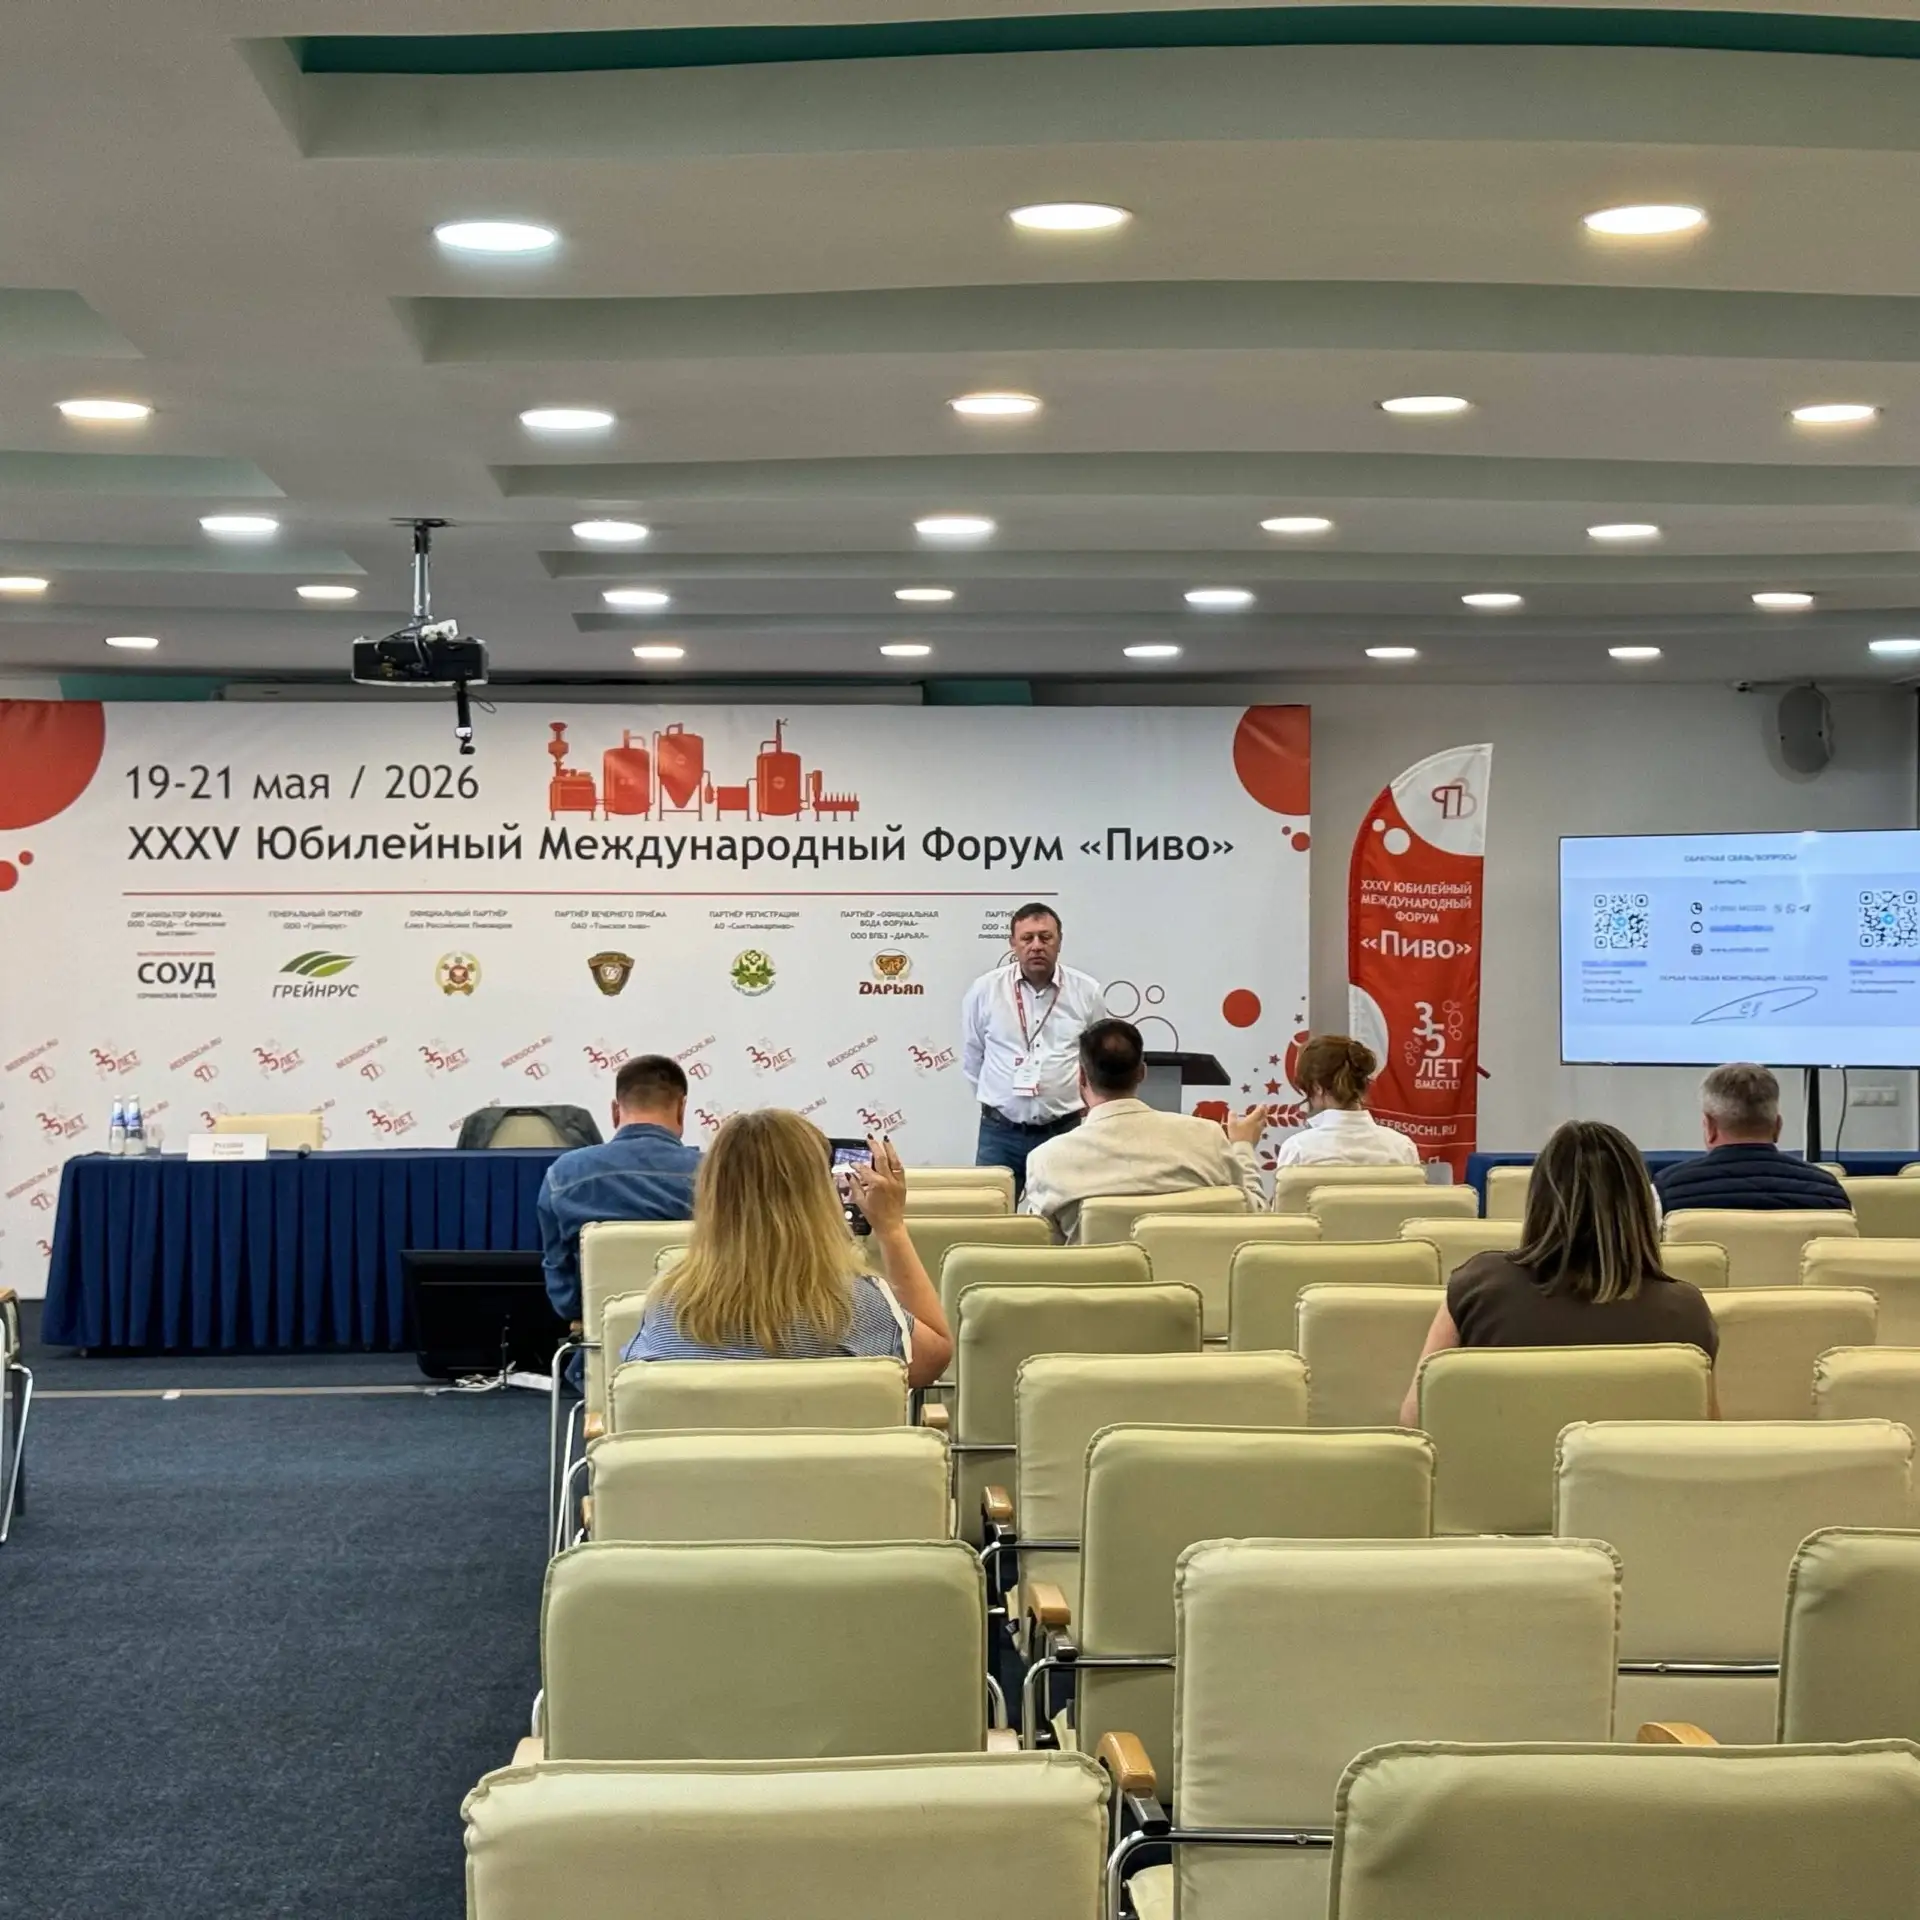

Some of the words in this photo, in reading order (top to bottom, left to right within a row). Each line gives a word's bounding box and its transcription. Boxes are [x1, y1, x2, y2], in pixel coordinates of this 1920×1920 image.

[126, 765, 231, 799] 19-21
[253, 774, 330, 799] мая
[385, 765, 479, 799] 2026
[128, 826, 240, 860] XXXV
[257, 822, 521, 860] Юбилейный
[539, 824, 905, 869] Международный
[922, 826, 1064, 870] Форум
[1079, 827, 1235, 861] «Пиво»
[1361, 880, 1389, 892] XXXV
[1394, 881, 1472, 895] ЮБИЛЕЙНЫЙ
[1361, 894, 1472, 911] МЕЖДУНАРОДНЫЙ
[592, 910, 633, 918] ВЕЧЕРНЕГО
[841, 910, 875, 918] ПАРТНЁР
[985, 909, 1015, 918] ПАРТНЁ
[1396, 911, 1439, 923] ФОРУМ
[1361, 929, 1472, 958] «Пиво»
[138, 962, 215, 989] СОУД
[272, 981, 360, 998] ГРЕЙНРУС
[1413, 1002, 1446, 1057] 35
[771, 1047, 793, 1067] ЛЕТ
[933, 1047, 955, 1067] ЛЕТ
[1416, 1058, 1462, 1078] ЛЕТ
[882, 1109, 904, 1130] ЛЕТ
